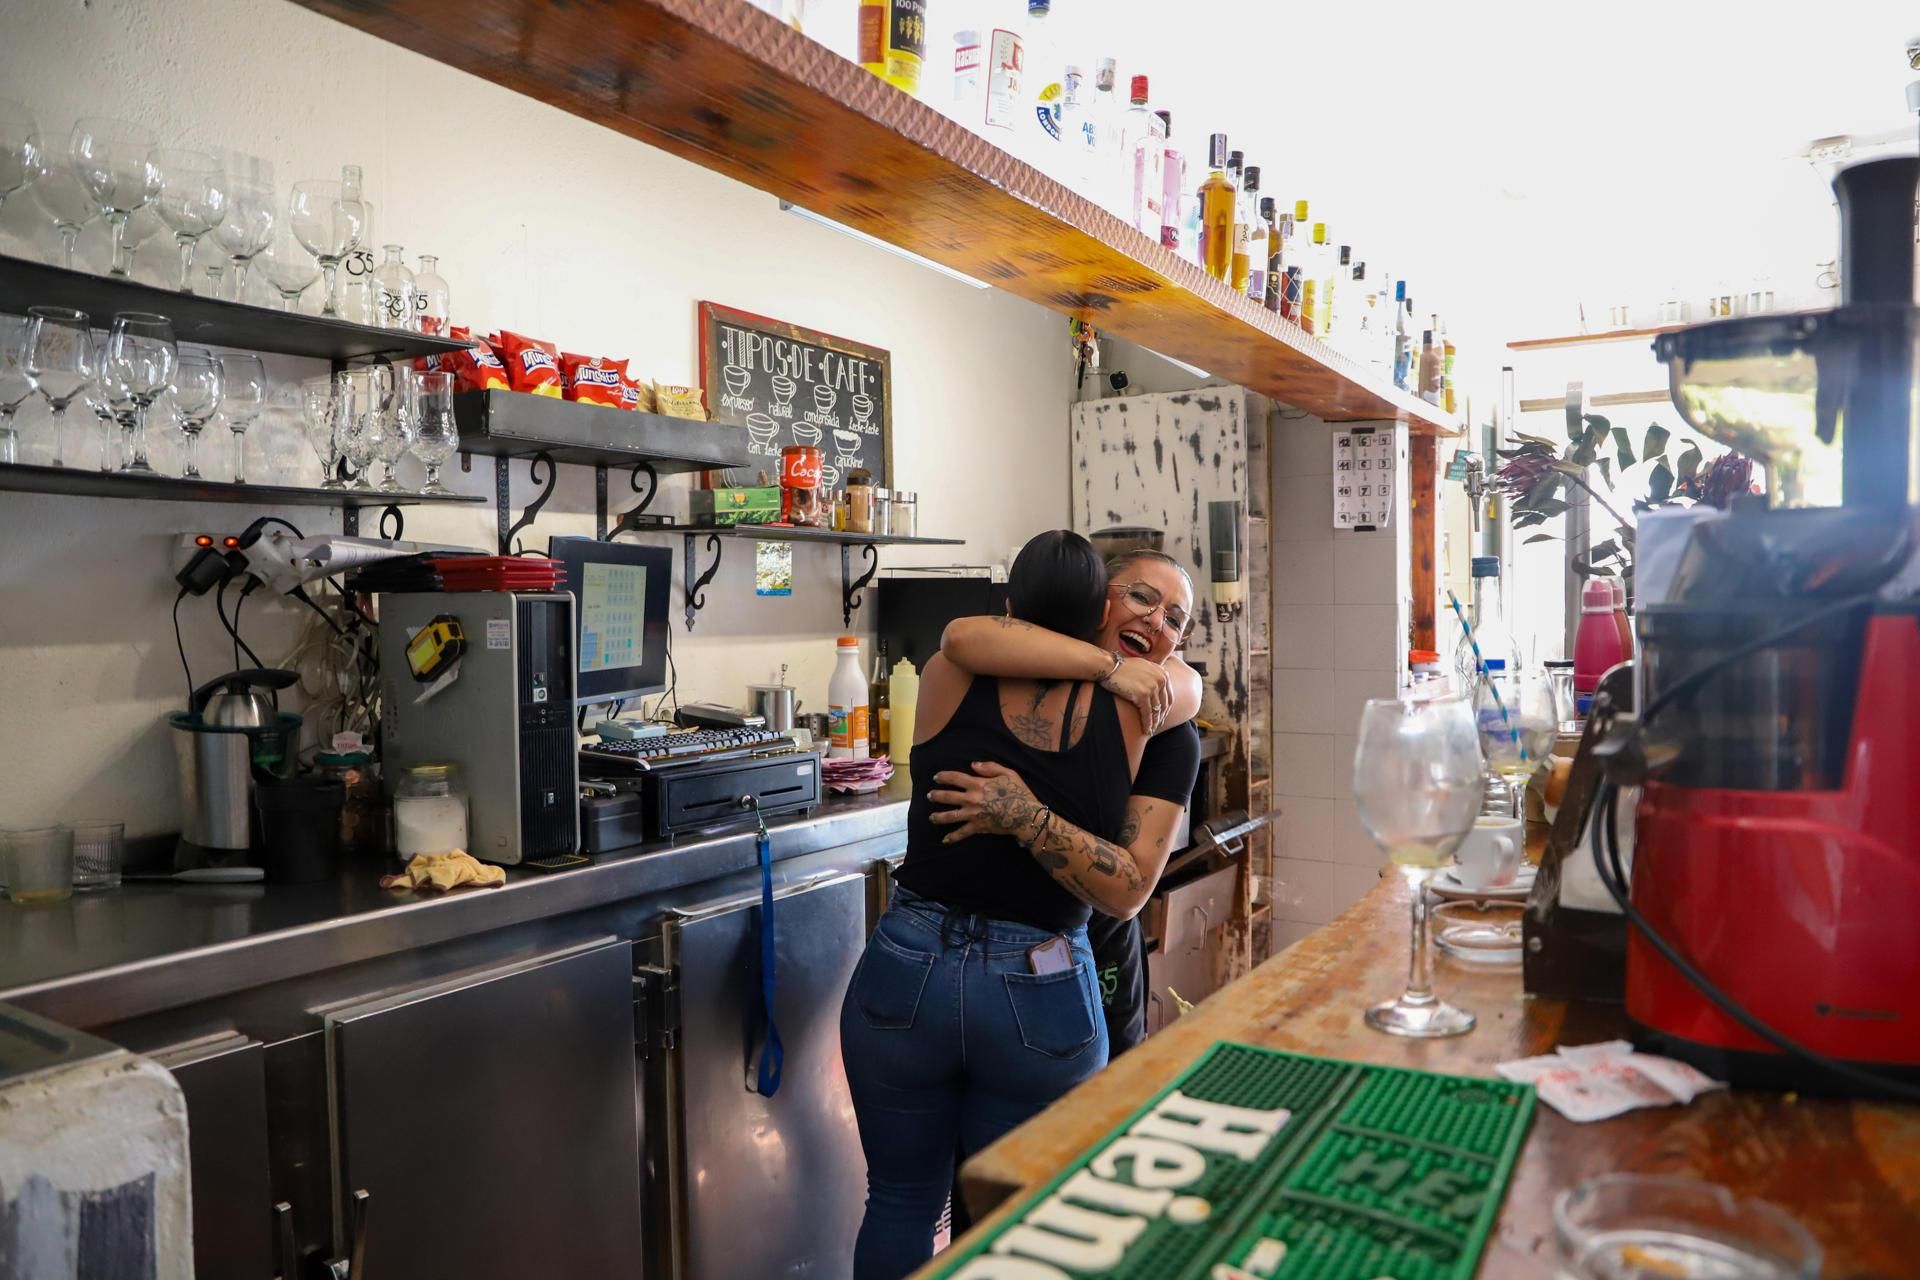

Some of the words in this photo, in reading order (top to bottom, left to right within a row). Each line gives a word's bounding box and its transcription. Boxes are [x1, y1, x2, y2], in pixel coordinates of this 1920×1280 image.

[345, 250, 374, 276] 35
[721, 325, 788, 377] TIPOS
[791, 344, 815, 383] DE
[823, 352, 870, 397] CAFE
